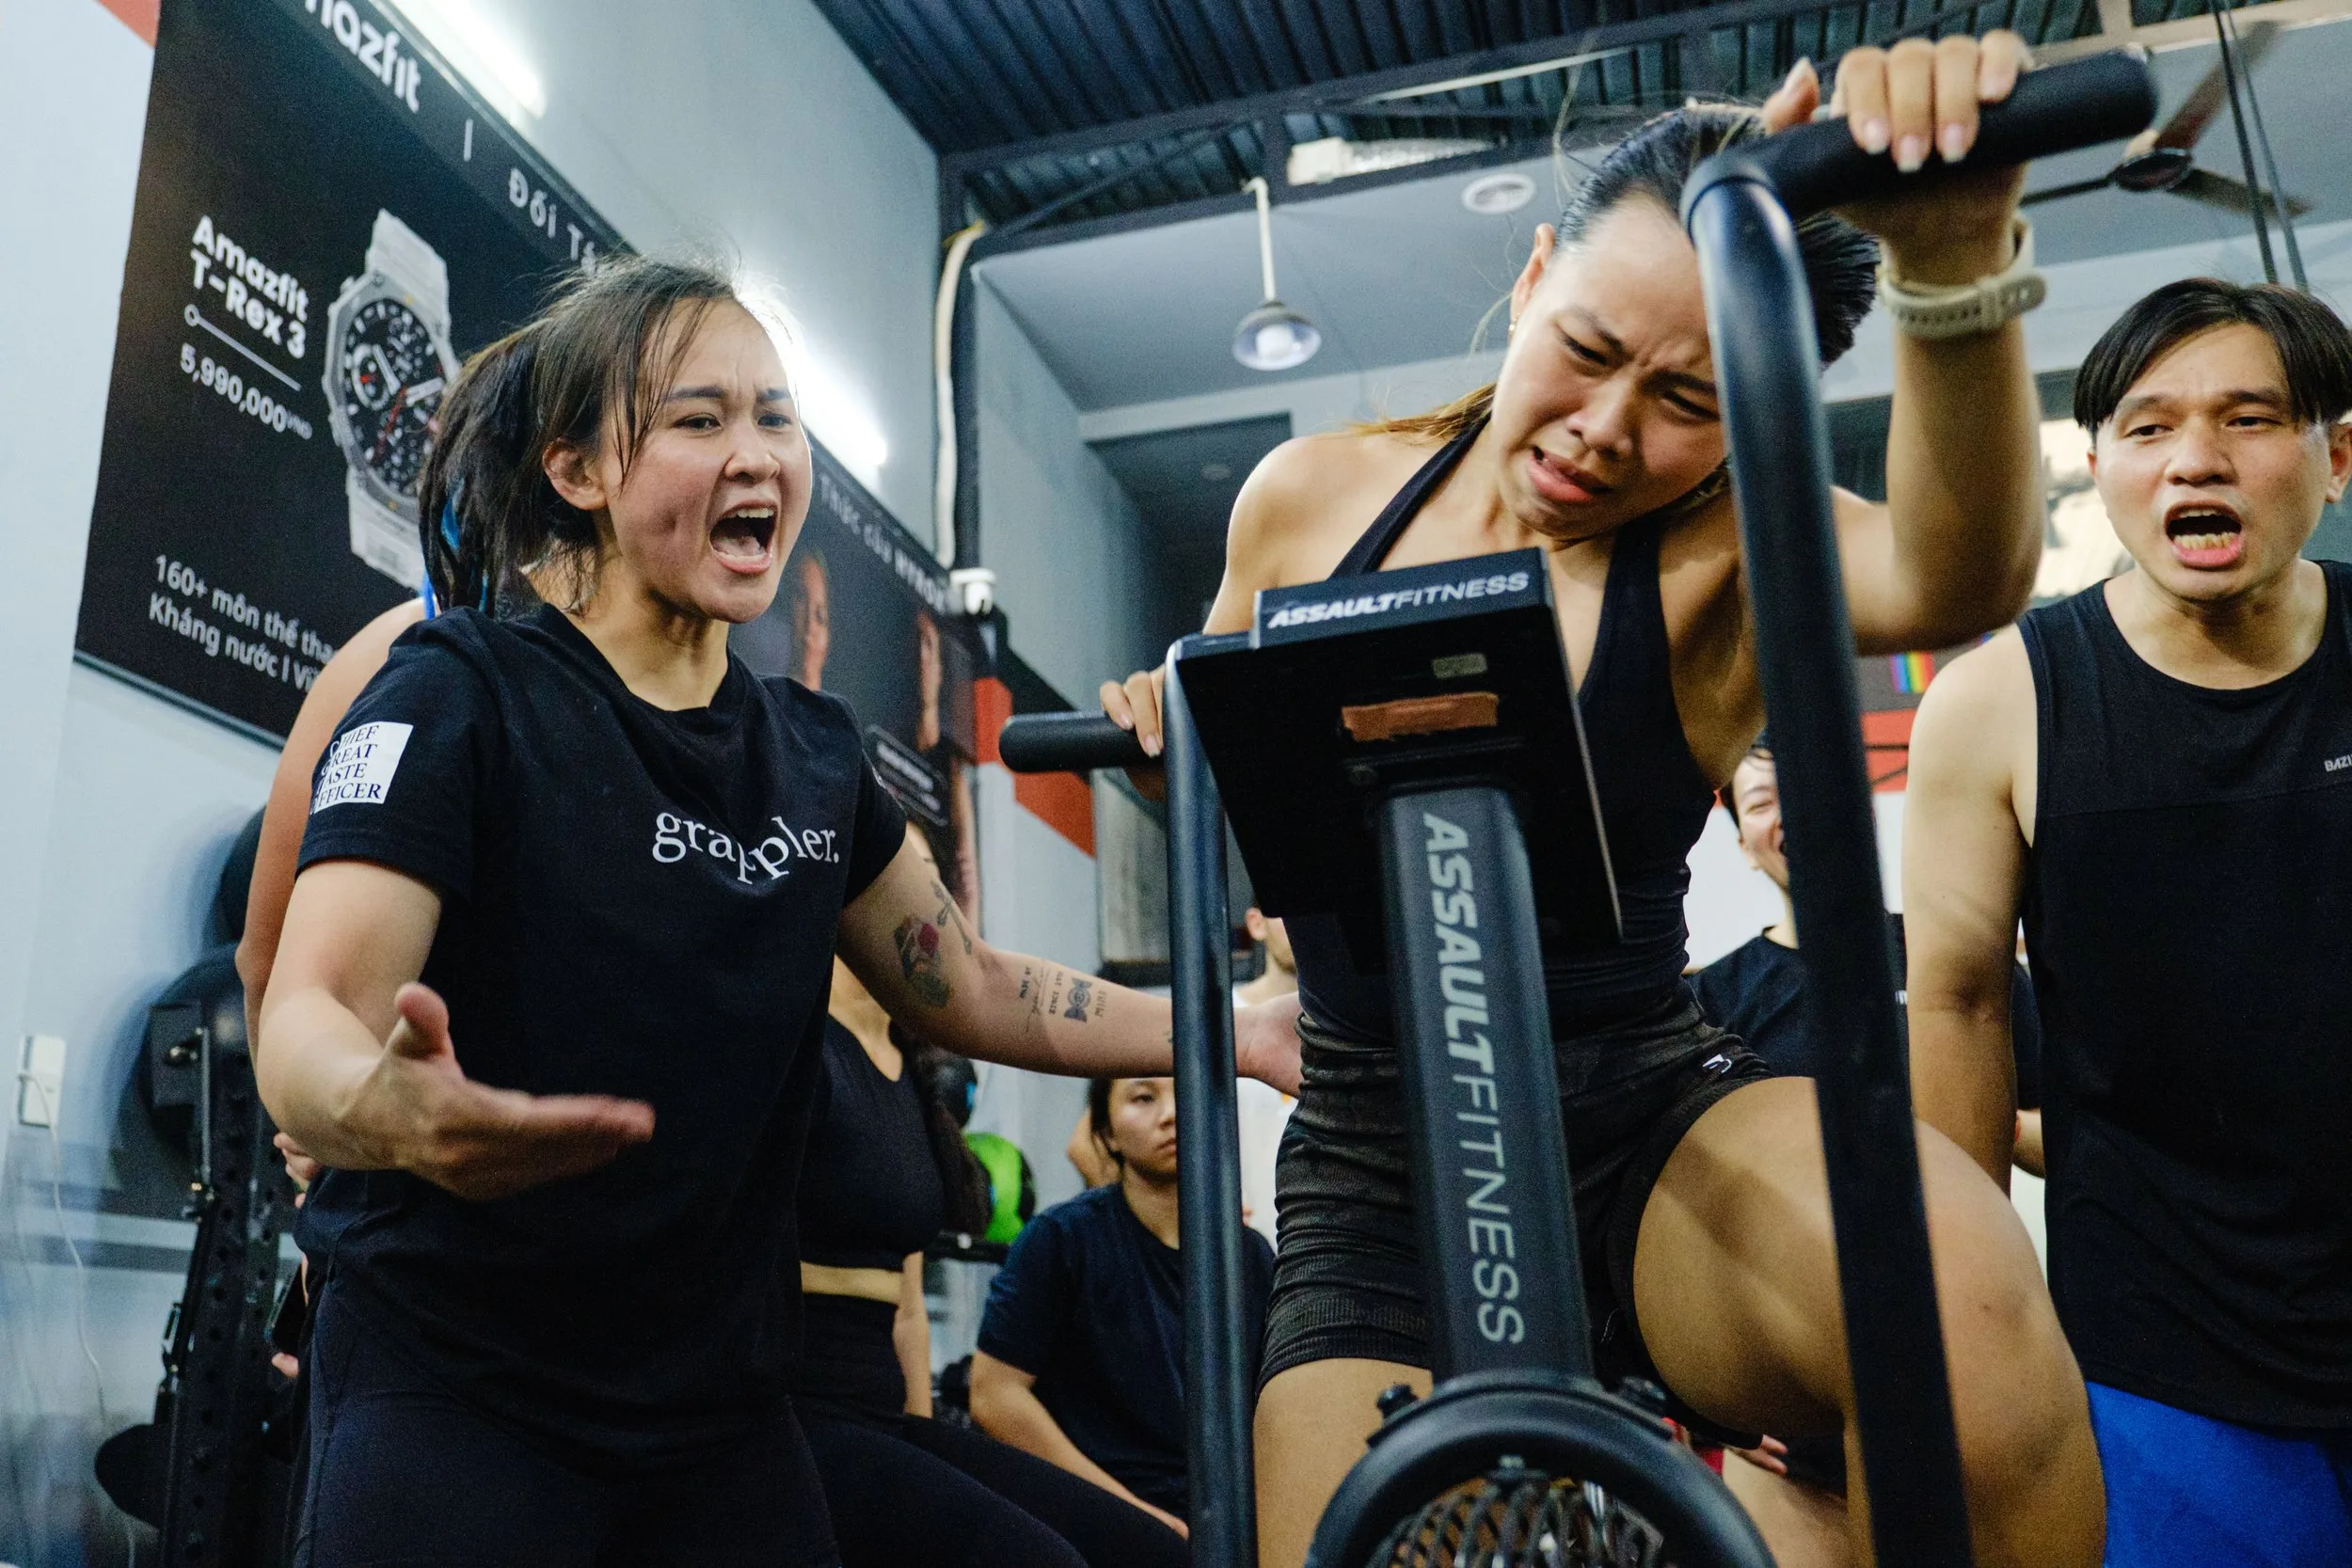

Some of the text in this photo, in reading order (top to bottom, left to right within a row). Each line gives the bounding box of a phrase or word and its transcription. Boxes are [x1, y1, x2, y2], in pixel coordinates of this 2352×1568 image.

[190, 248, 307, 358] T-Rex 3
[192, 214, 309, 323] Amazfit
[149, 592, 221, 657] Kháng
[225, 635, 278, 678] nước
[155, 554, 208, 598] 160+
[211, 587, 260, 630] môn
[301, 629, 337, 665] tha
